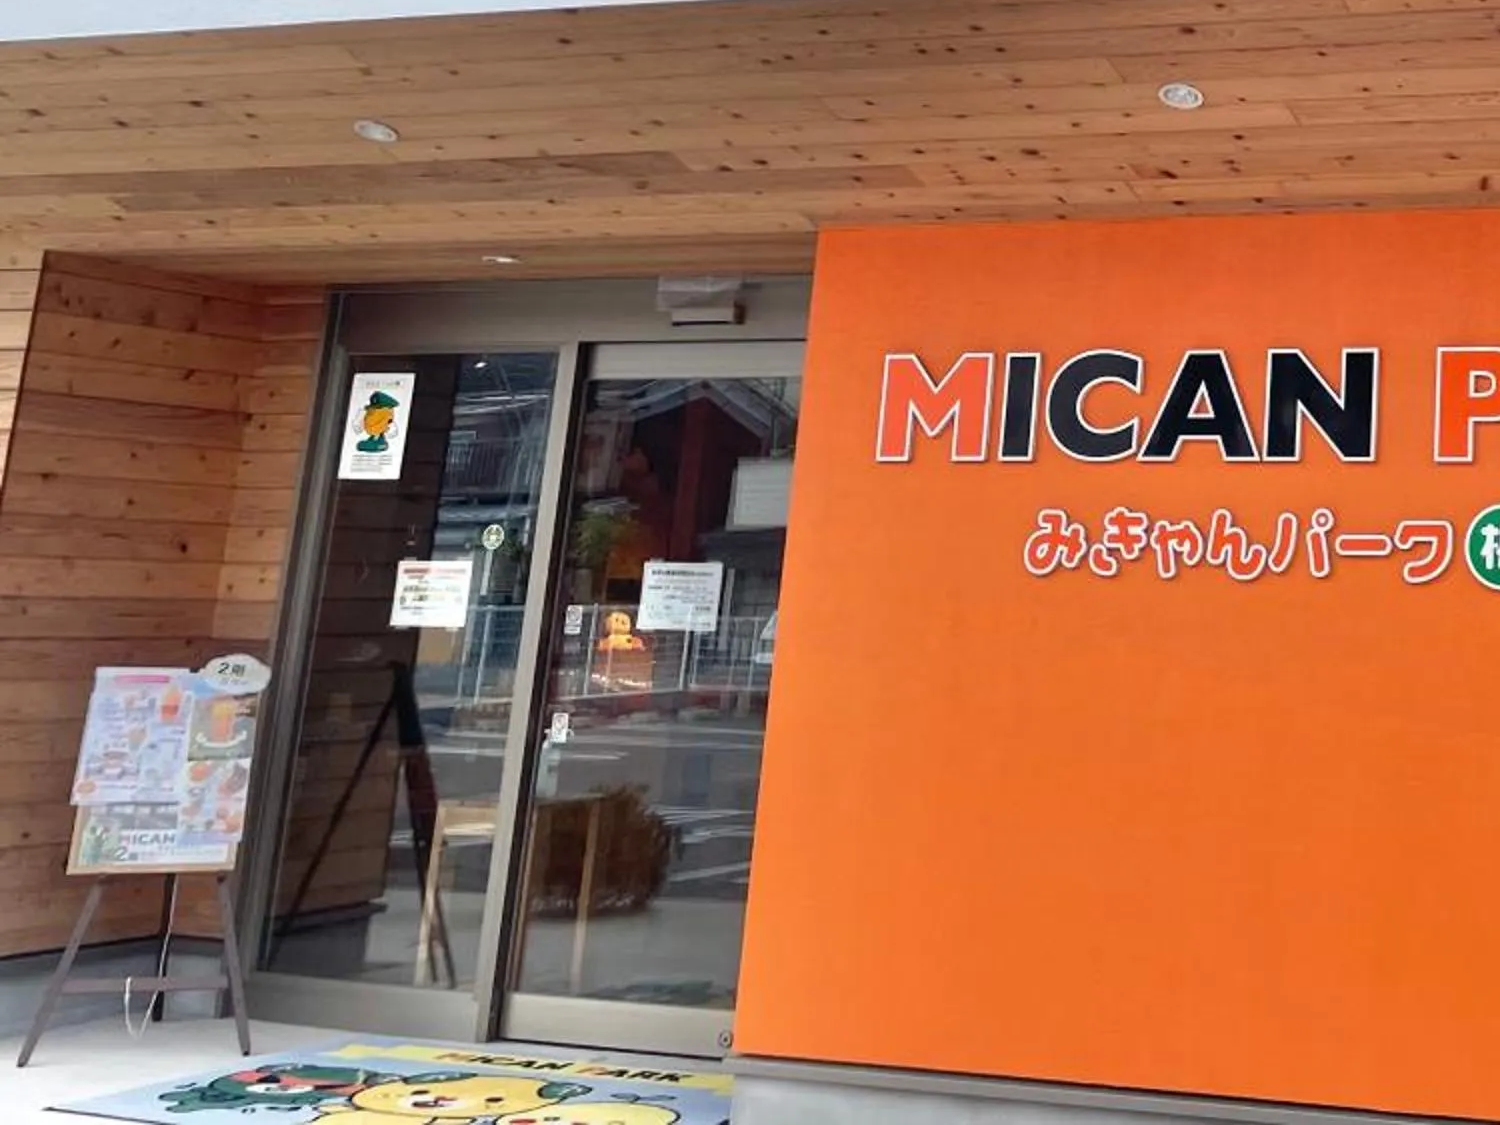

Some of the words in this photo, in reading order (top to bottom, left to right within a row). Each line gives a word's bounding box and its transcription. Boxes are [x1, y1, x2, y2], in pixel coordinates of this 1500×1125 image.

[875, 348, 1379, 464] MICAN
[435, 1053, 573, 1070] MICAN
[576, 1066, 693, 1083] PARK
